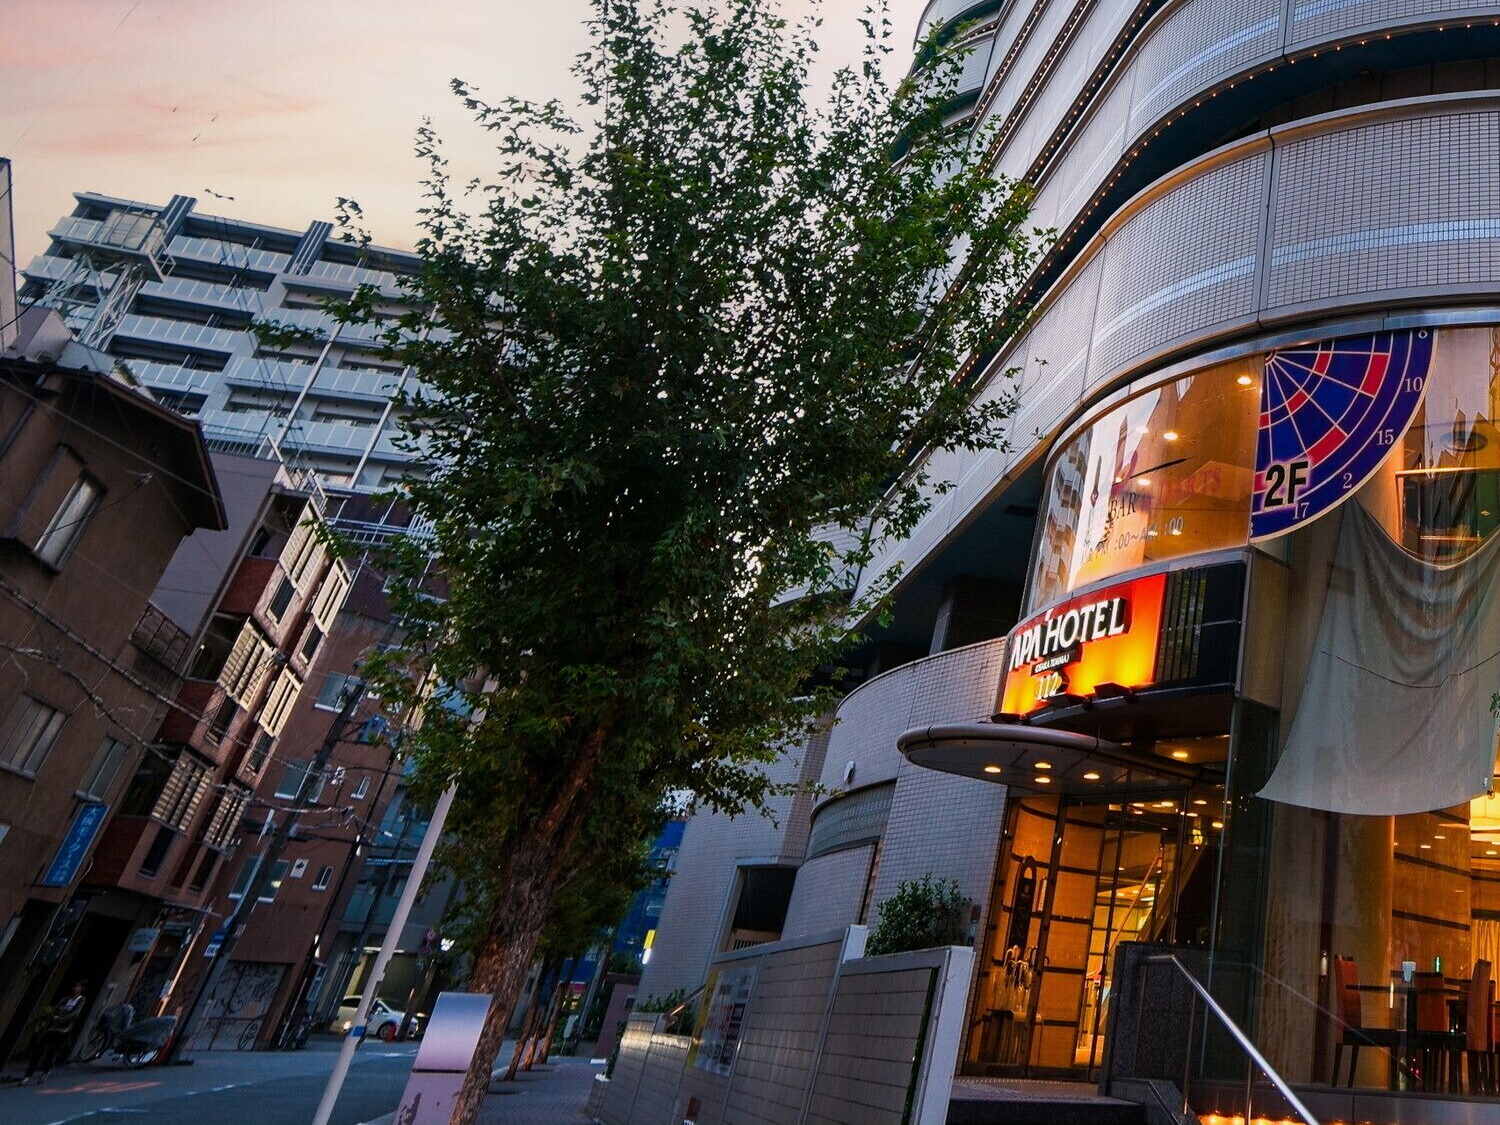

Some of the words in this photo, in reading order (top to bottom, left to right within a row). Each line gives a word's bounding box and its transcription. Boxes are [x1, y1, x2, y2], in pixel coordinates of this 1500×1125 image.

[1405, 377, 1423, 393] 10
[1377, 429, 1394, 446] 15
[1264, 461, 1309, 508] 2F
[1343, 472, 1353, 489] 2
[1292, 502, 1310, 520] 17
[1009, 624, 1042, 672] APA
[1043, 597, 1125, 655] HOTEL
